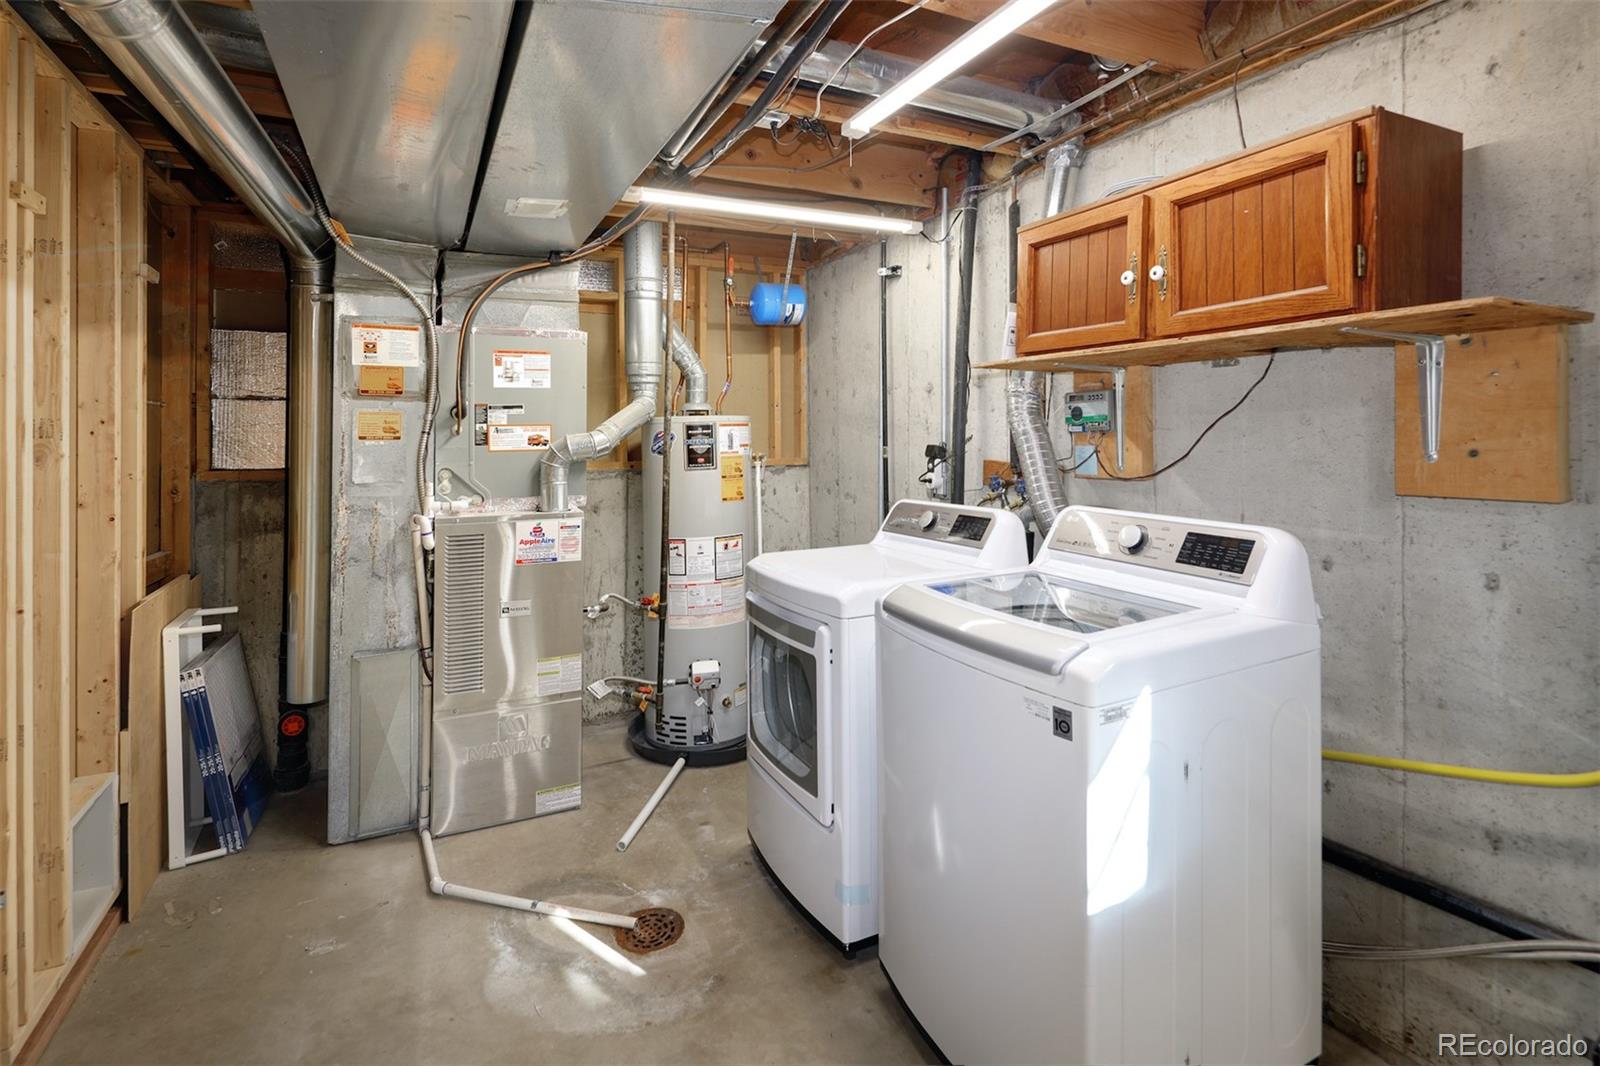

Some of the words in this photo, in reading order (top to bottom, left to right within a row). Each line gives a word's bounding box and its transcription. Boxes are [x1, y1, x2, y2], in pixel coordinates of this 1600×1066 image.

[519, 537, 555, 546] AppleAire
[1054, 718, 1071, 734] 10
[464, 735, 551, 764] MAYTAG
